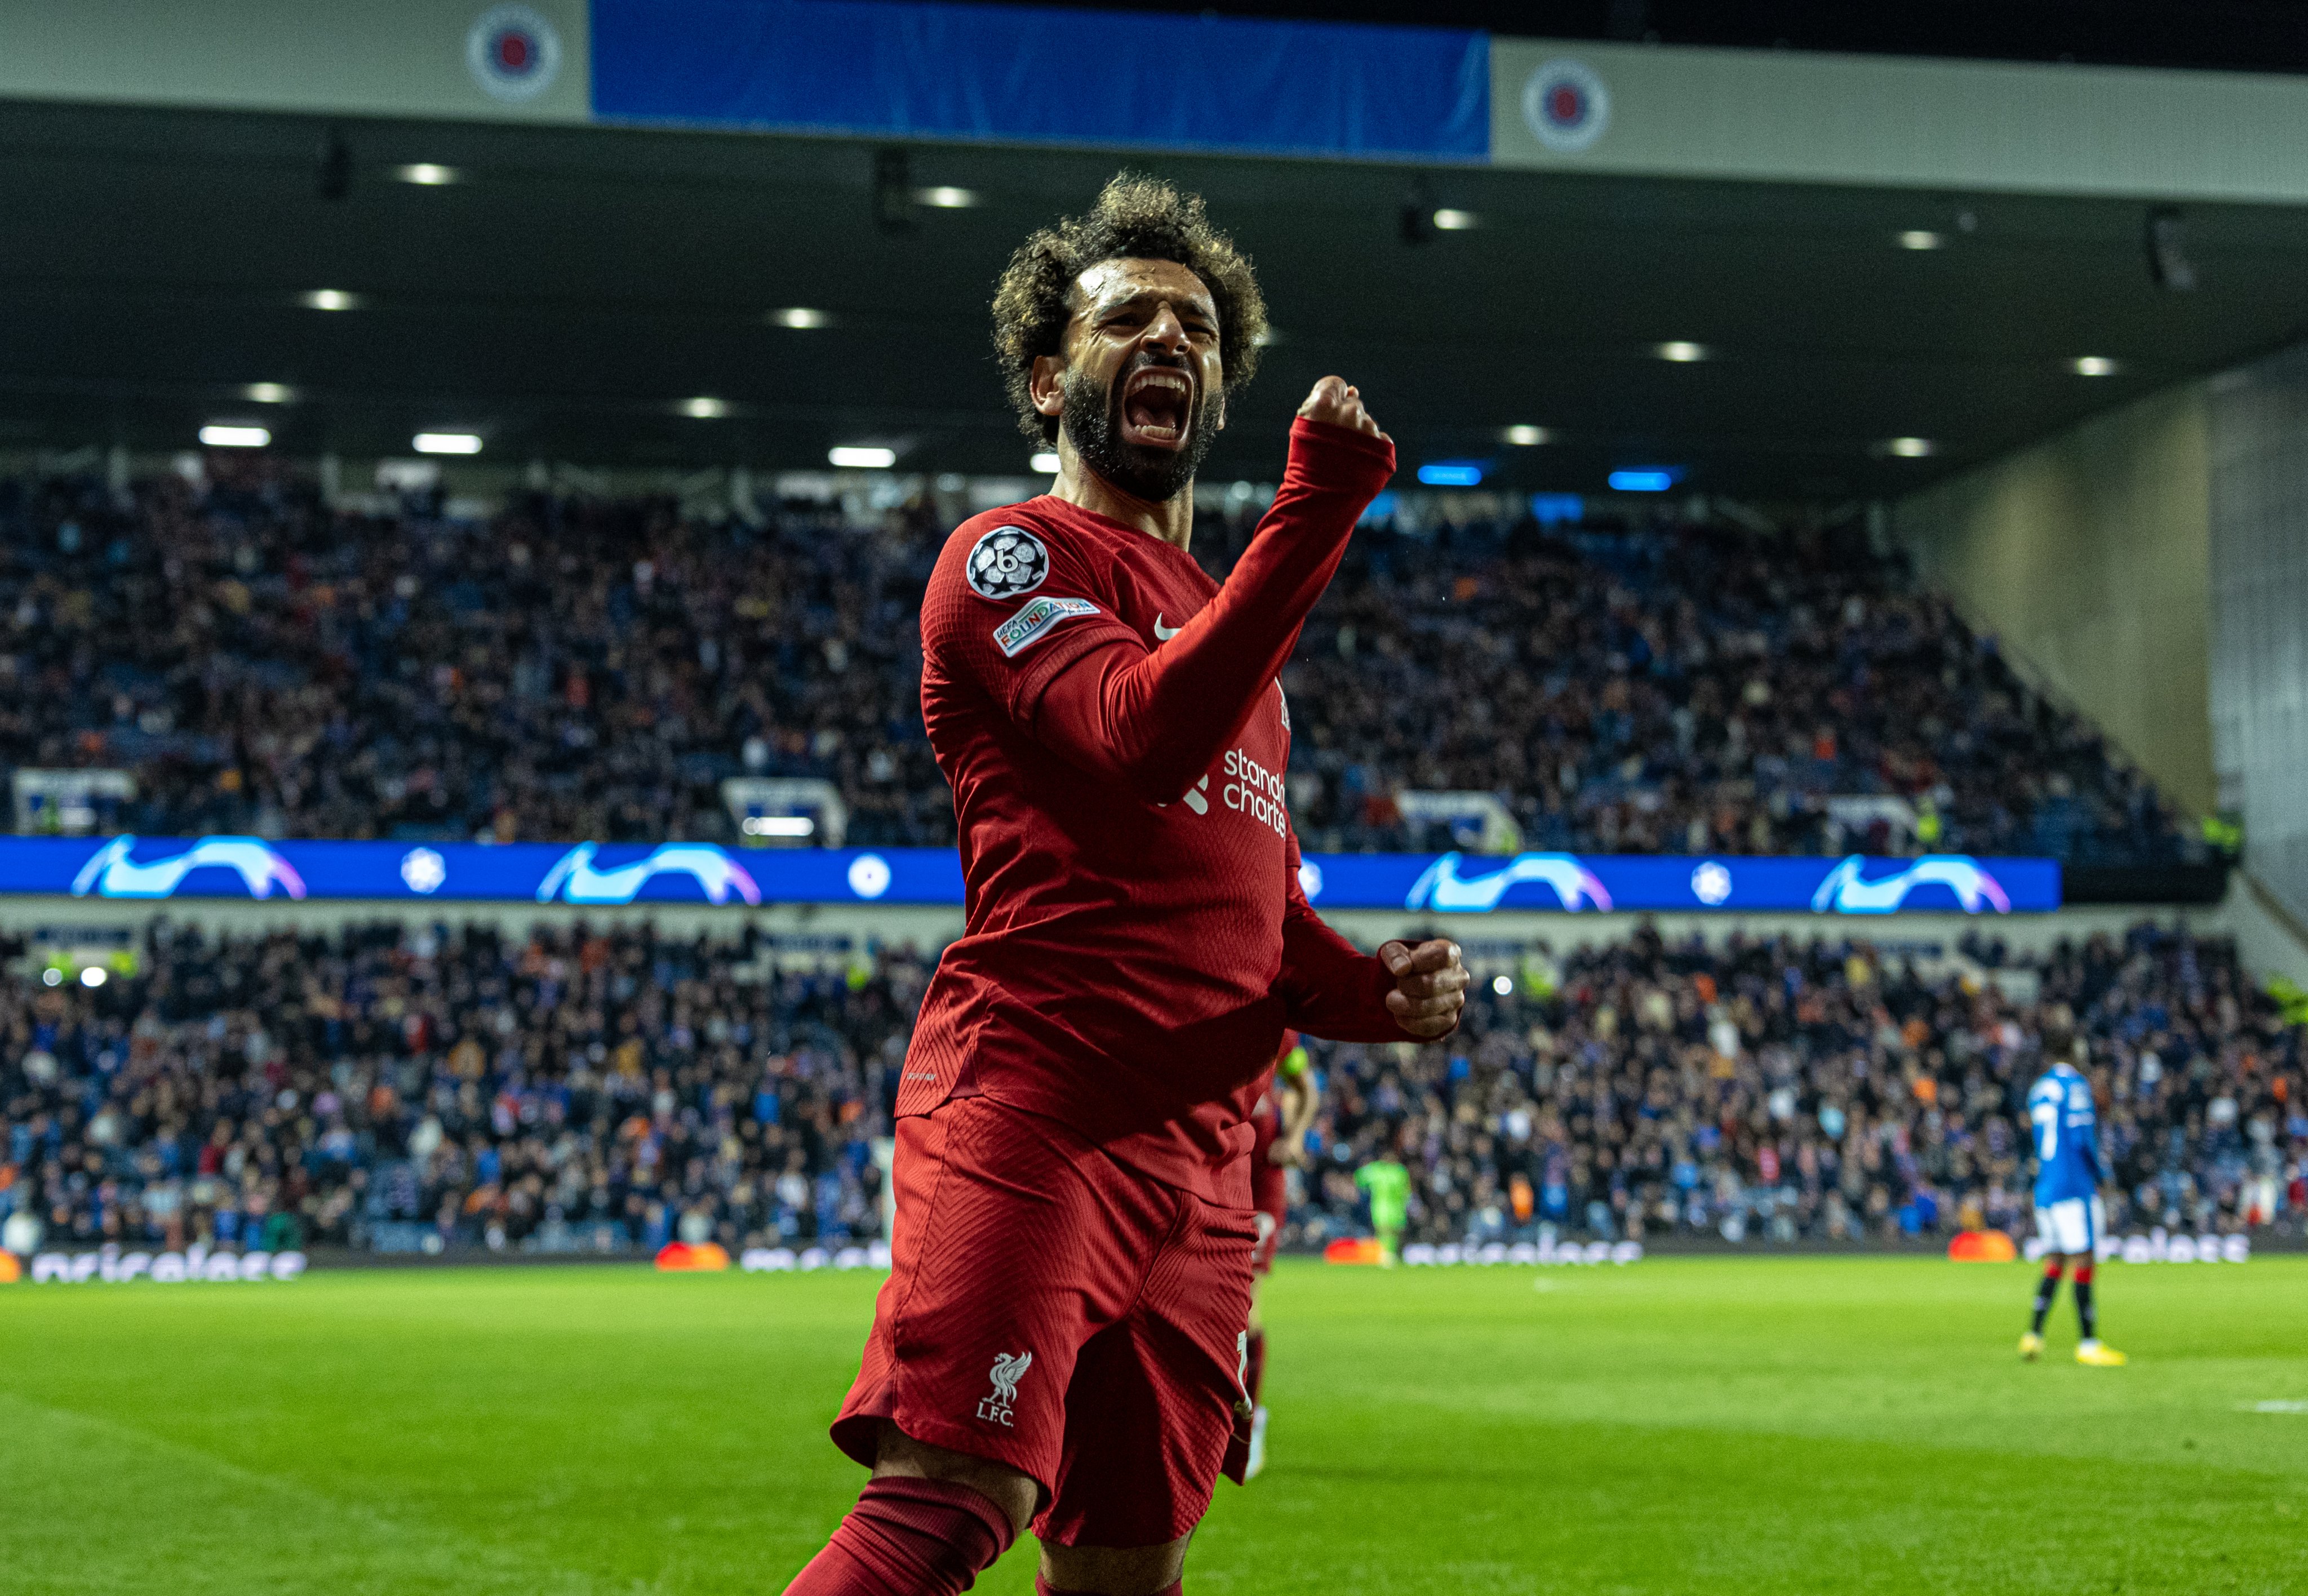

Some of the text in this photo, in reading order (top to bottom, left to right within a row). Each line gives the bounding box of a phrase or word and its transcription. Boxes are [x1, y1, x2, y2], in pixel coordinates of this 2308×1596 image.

[997, 549, 1019, 574] 6
[997, 619, 1018, 638] UEFA
[1001, 601, 1090, 647] FOUNDATION
